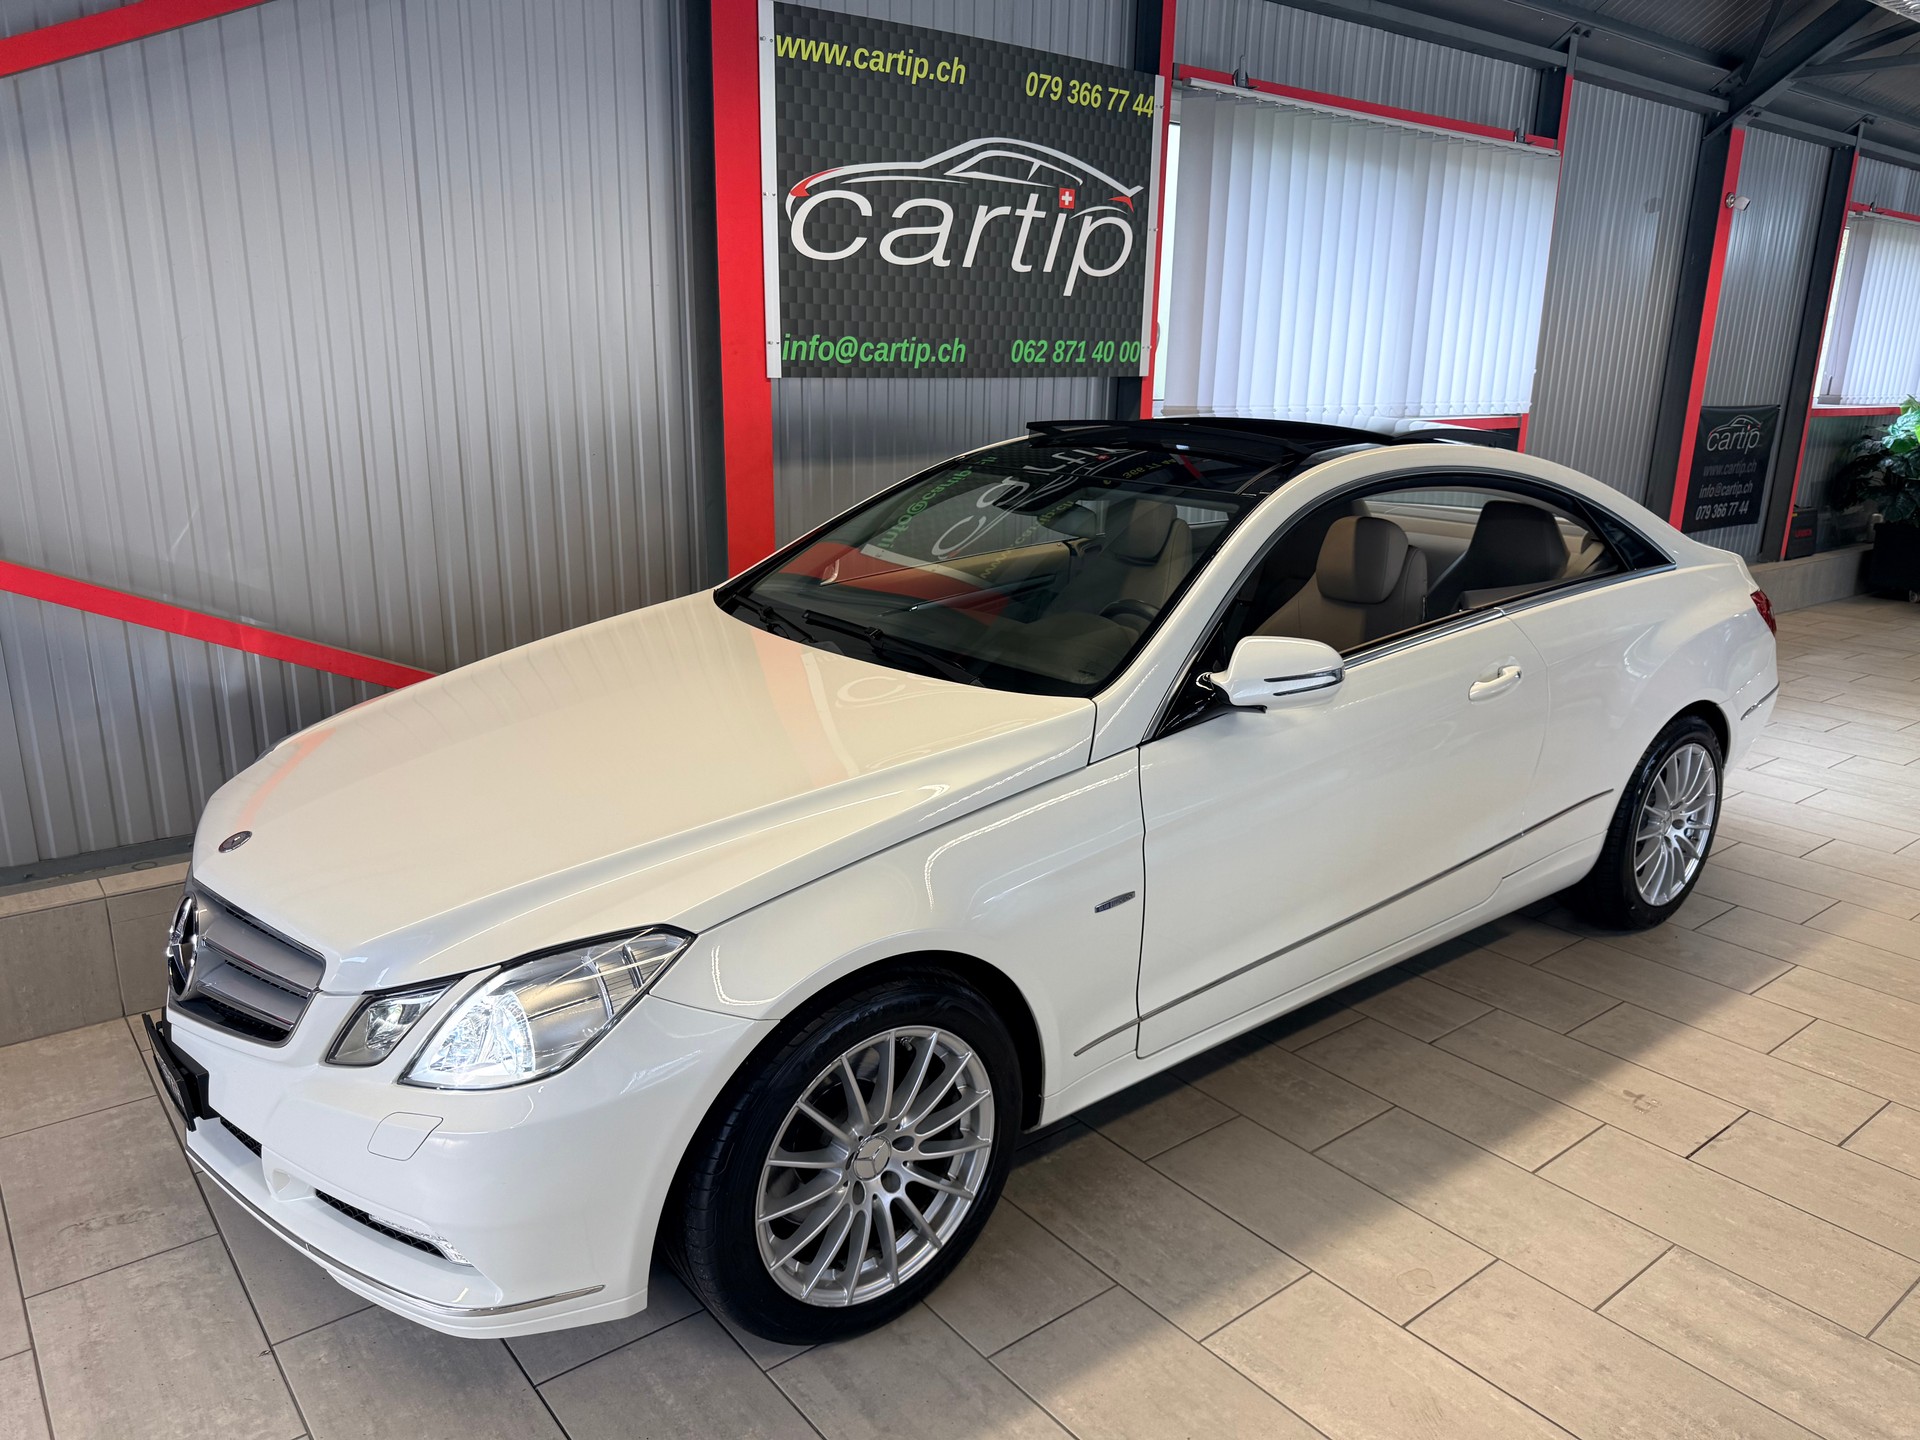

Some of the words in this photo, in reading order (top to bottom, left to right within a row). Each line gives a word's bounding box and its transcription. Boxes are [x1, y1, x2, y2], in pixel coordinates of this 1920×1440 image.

[776, 34, 966, 85] www.cartip.ch
[1025, 71, 1063, 101] 079
[1067, 79, 1103, 108] 366
[1107, 86, 1130, 112] 77
[1132, 93, 1155, 118] 44
[790, 188, 1133, 297] cartip
[782, 333, 966, 369] info@cartip.ch
[1011, 339, 1048, 363] 062
[1052, 340, 1086, 363] 871
[1091, 340, 1115, 363] 40
[1119, 341, 1141, 363] 00
[1706, 425, 1760, 455] cartip
[1703, 458, 1757, 477] www.cartip.ch
[1698, 480, 1754, 499] info@cartip.ch
[1695, 504, 1711, 521] 079
[1711, 502, 1728, 519] 366
[1727, 501, 1739, 516] 77
[1739, 500, 1750, 515] 44
